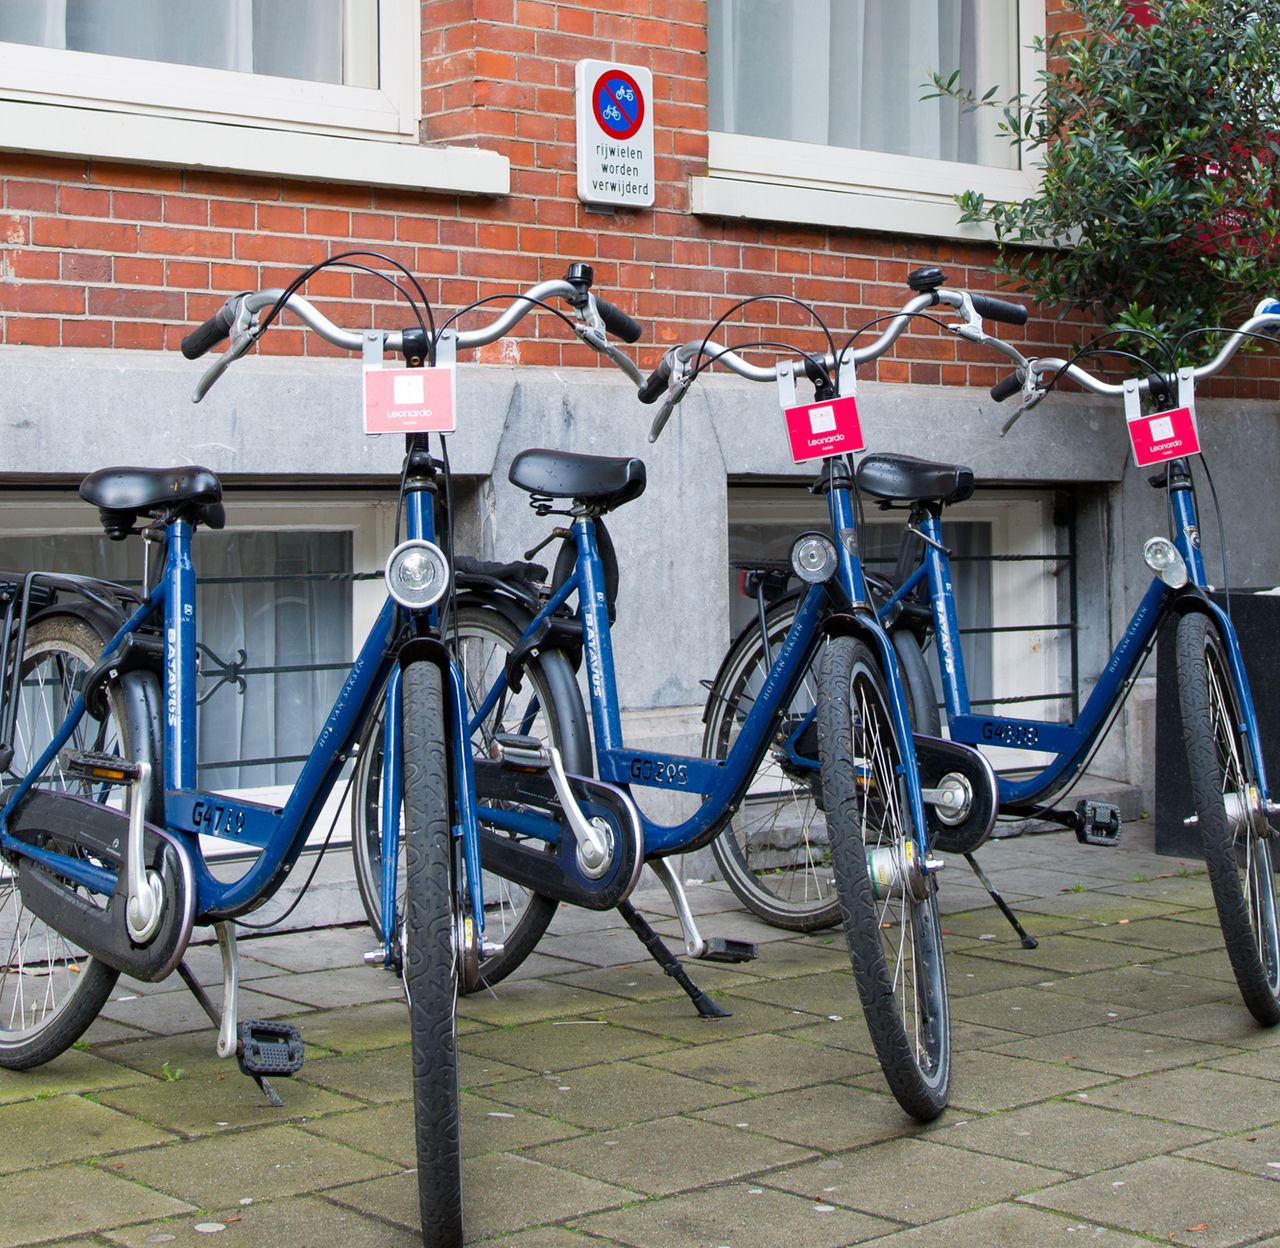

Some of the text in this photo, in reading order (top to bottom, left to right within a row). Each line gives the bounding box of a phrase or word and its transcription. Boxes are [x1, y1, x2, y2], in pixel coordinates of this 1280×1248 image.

[595, 142, 643, 160] rijwielen
[601, 162, 639, 177] worden
[592, 179, 649, 197] verwijderd
[386, 407, 432, 419] Leonardo
[807, 433, 845, 447] Leonardo
[1149, 439, 1183, 454] Leonardo
[584, 613, 602, 699] BATAVUS
[167, 628, 177, 727] BATAVUS
